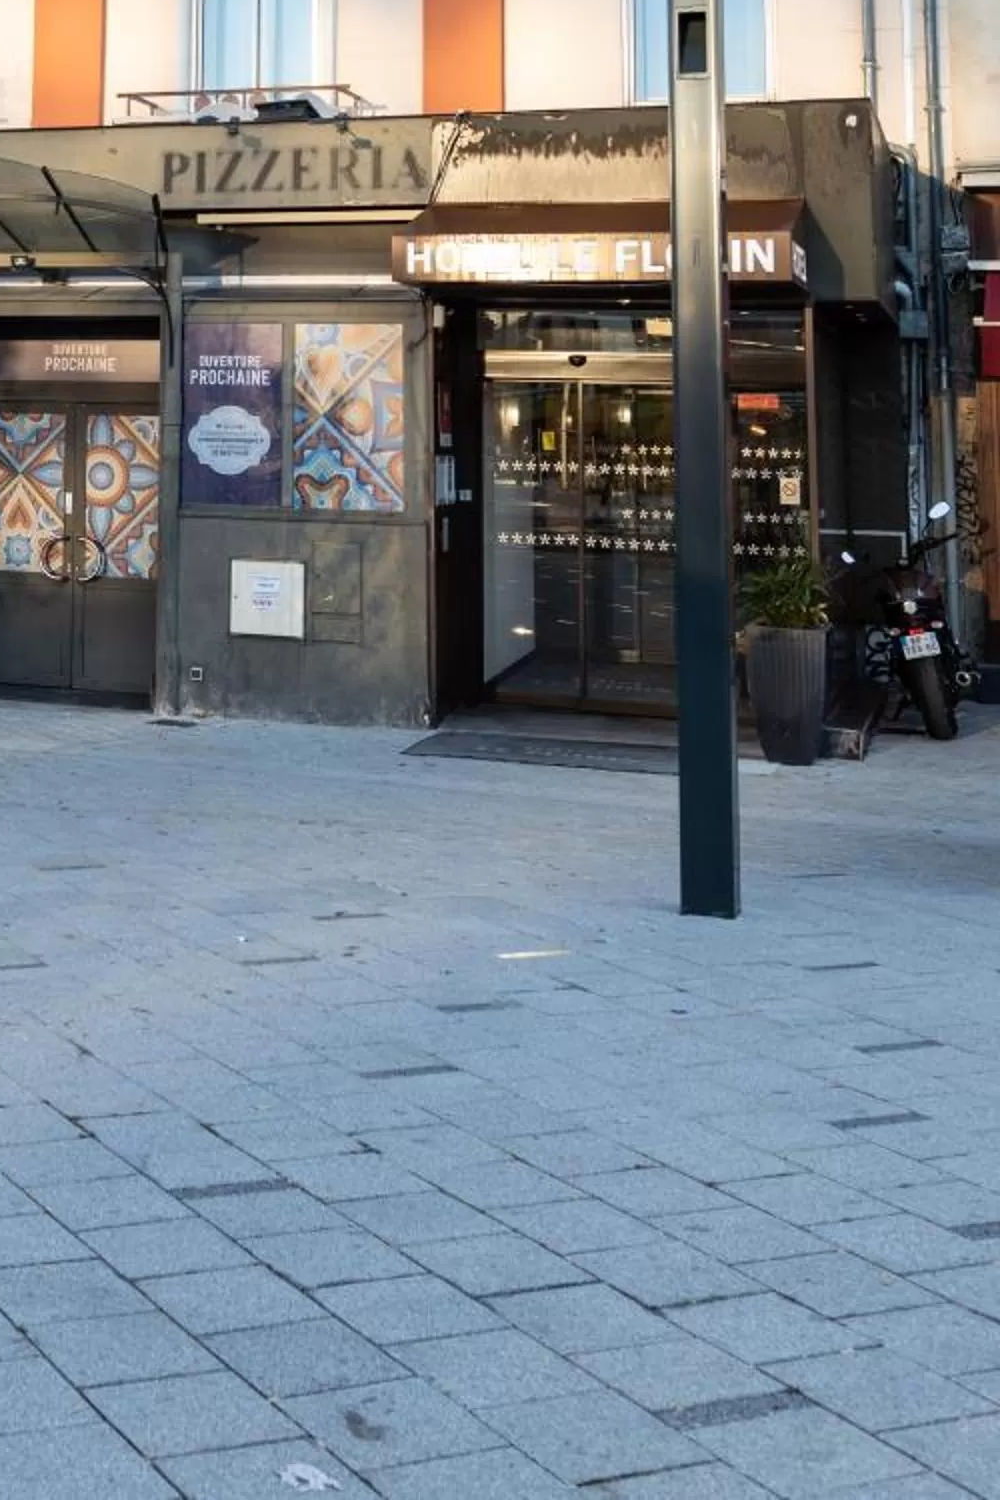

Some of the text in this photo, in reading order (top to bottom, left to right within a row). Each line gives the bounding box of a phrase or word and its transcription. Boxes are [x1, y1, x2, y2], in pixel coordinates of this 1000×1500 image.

[163, 147, 429, 194] PIZZERIA
[615, 238, 776, 274] FLIN
[44, 356, 117, 373] PROCHAINE
[199, 355, 263, 368] OUVERTURE
[189, 369, 271, 387] PROCHAINE
